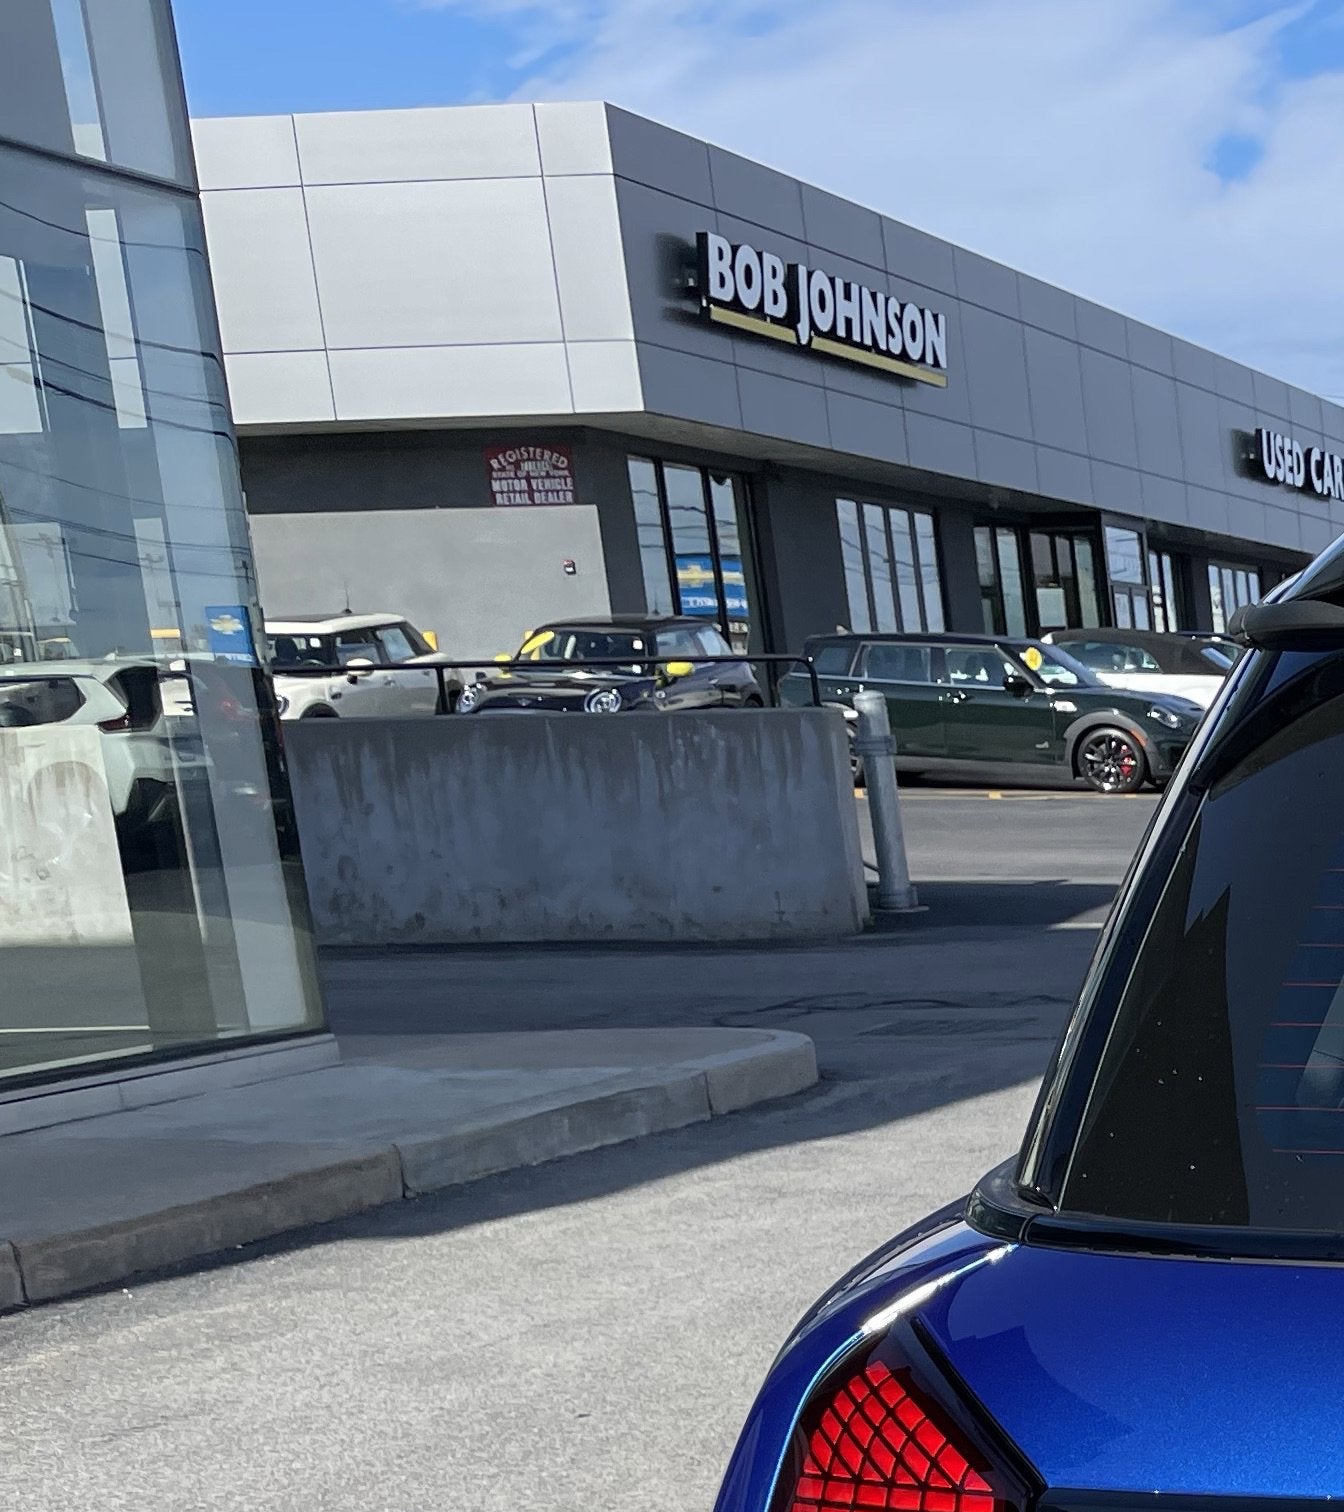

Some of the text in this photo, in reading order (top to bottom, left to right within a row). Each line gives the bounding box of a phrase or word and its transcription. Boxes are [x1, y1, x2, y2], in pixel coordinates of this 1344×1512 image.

[707, 231, 948, 369] BOB JOHNSON
[490, 447, 568, 470] REGISTERED
[1261, 428, 1305, 488] USED
[491, 477, 574, 492] MOTOR VEHICLE
[495, 491, 574, 505] RETAIL DEALER
